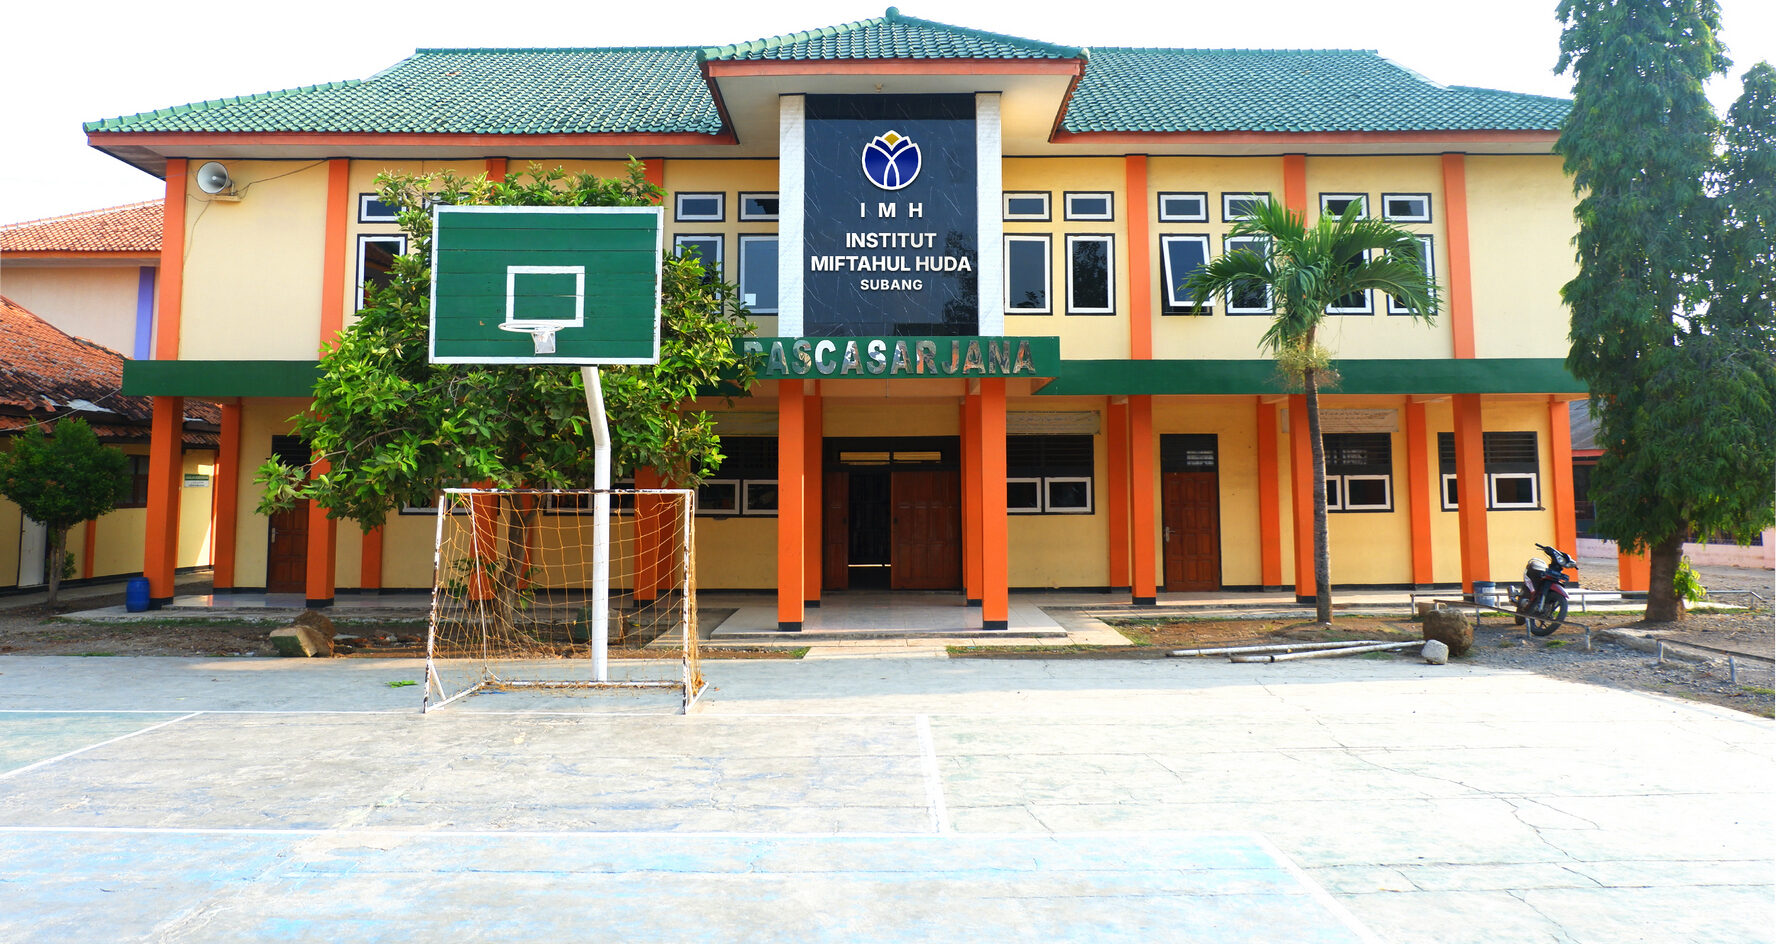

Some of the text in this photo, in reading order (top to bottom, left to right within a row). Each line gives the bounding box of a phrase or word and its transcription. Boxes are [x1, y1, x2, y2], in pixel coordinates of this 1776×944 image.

[846, 233, 937, 249] INSTITUT
[811, 256, 972, 272] MIFTAHUL HUDA
[860, 279, 923, 291] SUBANG
